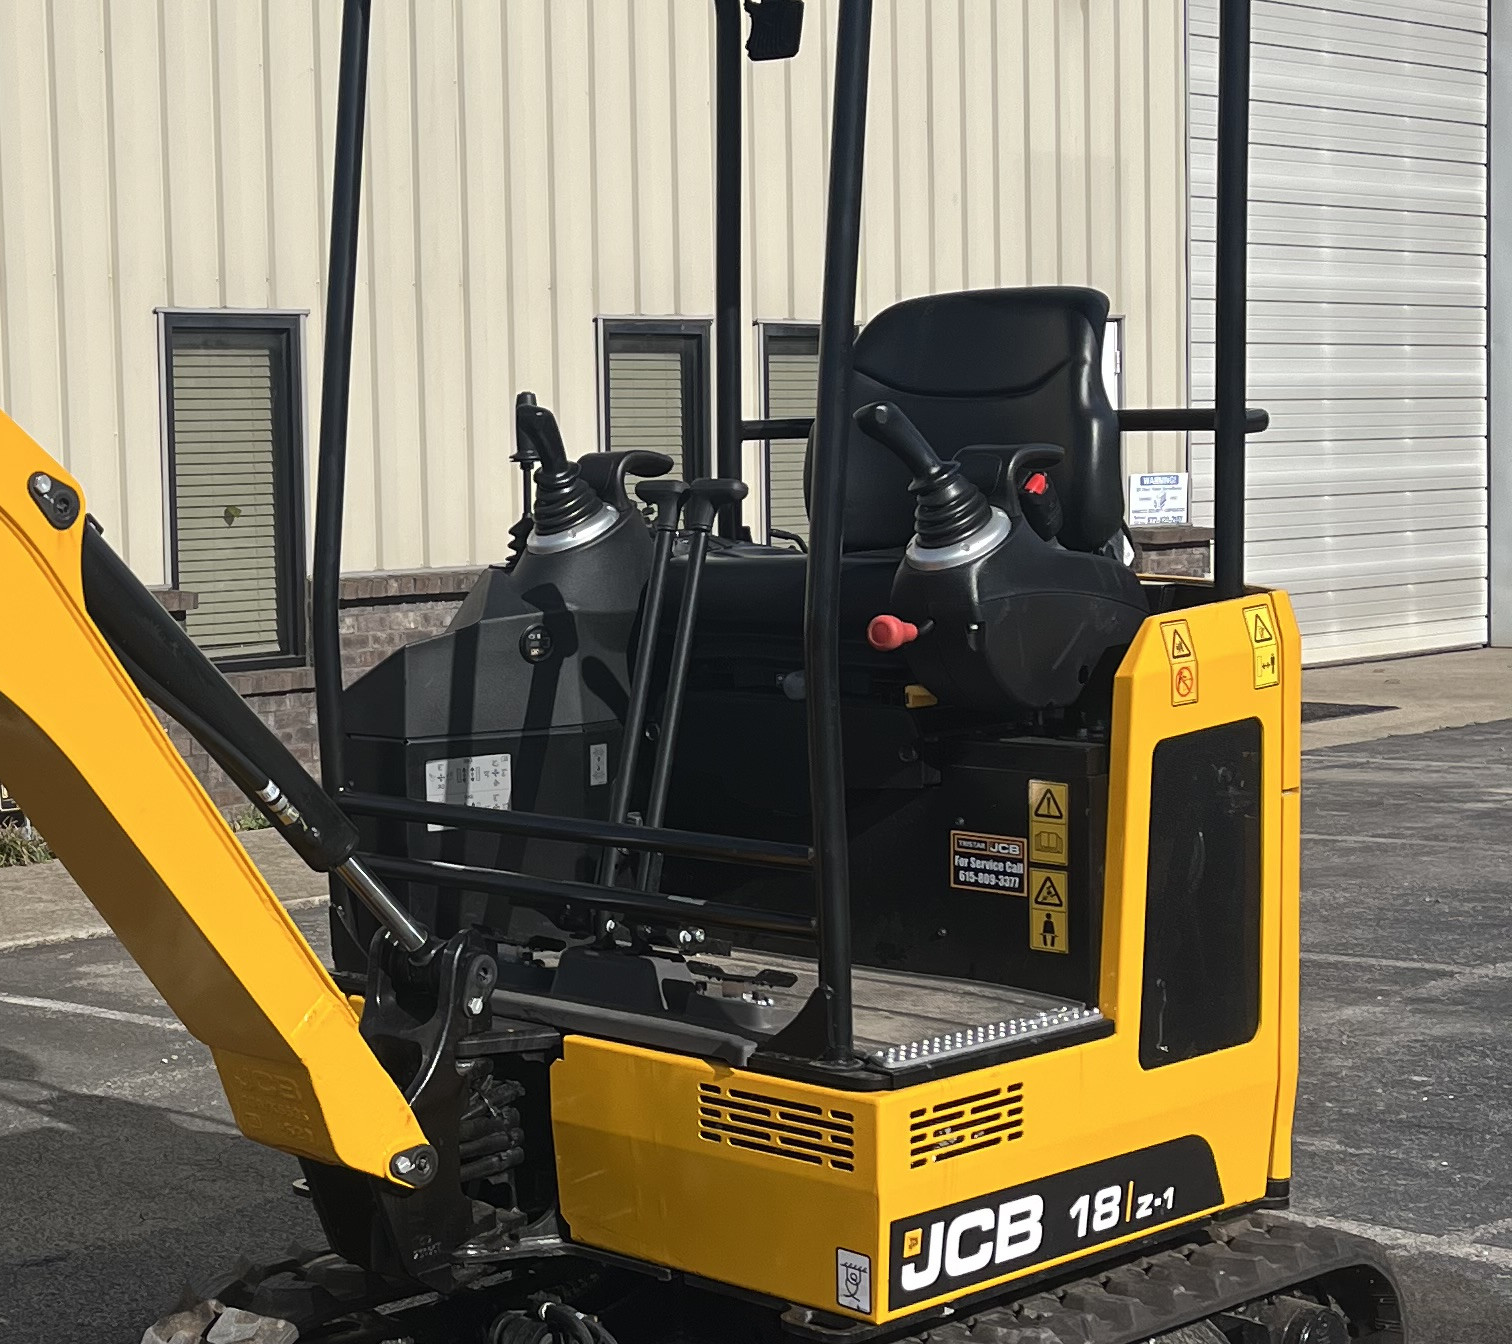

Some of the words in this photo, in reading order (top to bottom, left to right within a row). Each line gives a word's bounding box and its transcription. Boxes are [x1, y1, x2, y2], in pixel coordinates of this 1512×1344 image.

[958, 840, 986, 850] TRISTAR
[990, 842, 1020, 855] JCB
[954, 855, 969, 867] For
[970, 857, 1004, 871] Service
[1005, 861, 1024, 874] Call
[901, 1194, 1043, 1291] JCB
